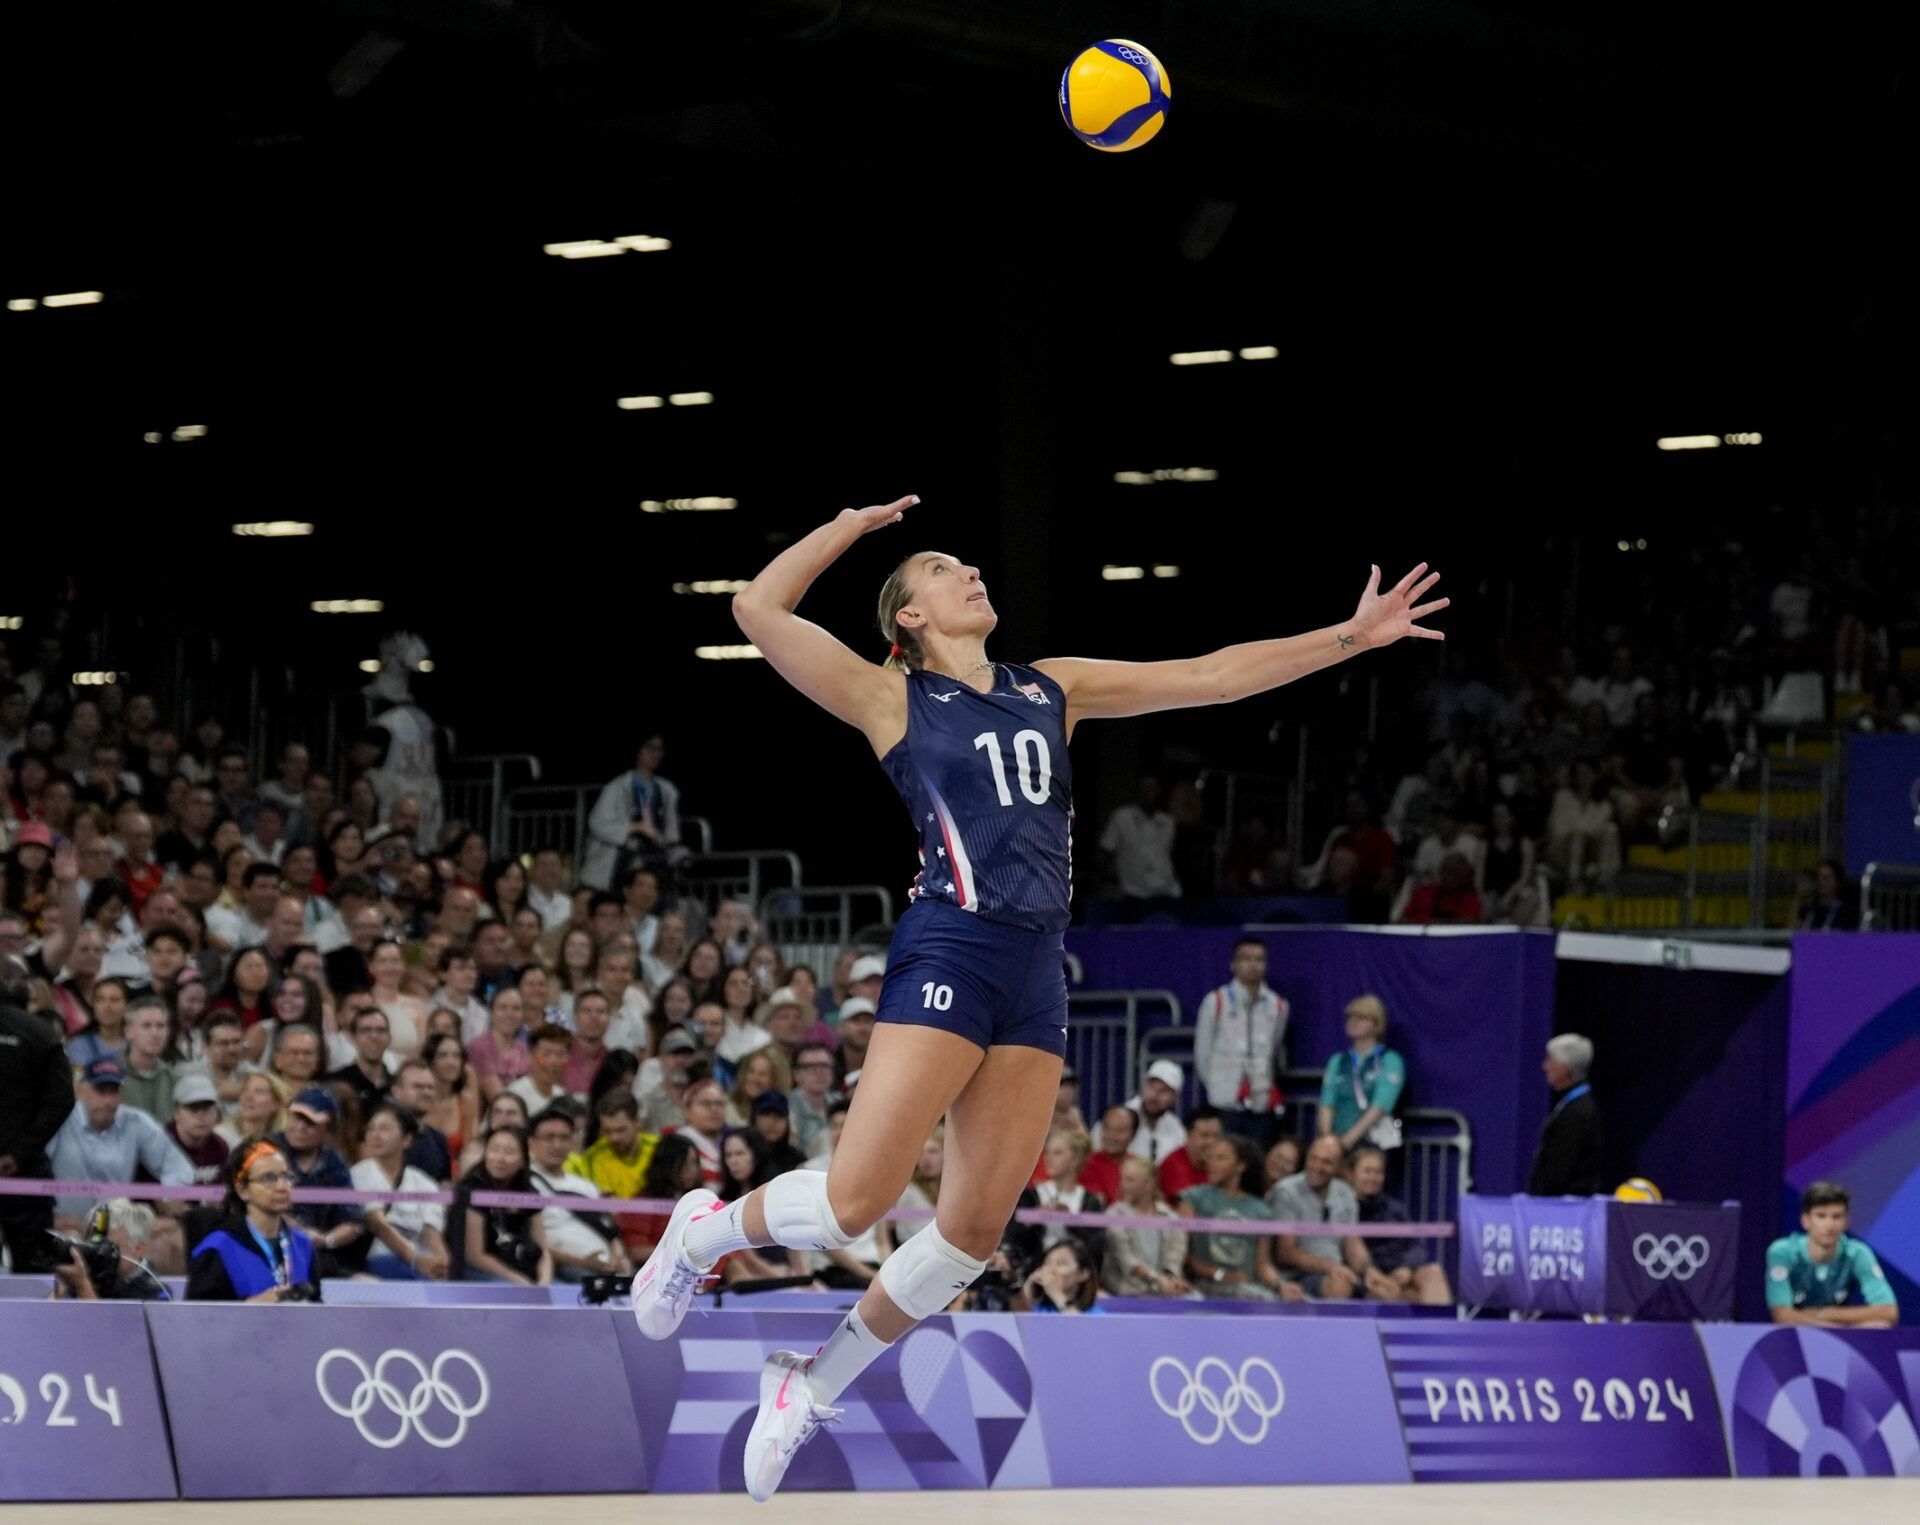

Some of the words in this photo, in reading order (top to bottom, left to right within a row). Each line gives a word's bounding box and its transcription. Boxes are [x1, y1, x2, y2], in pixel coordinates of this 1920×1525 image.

[973, 729, 1052, 807] 10
[921, 981, 954, 1012] 10
[1529, 1254, 1585, 1282] 2024
[1572, 1377, 1694, 1423] 2024
